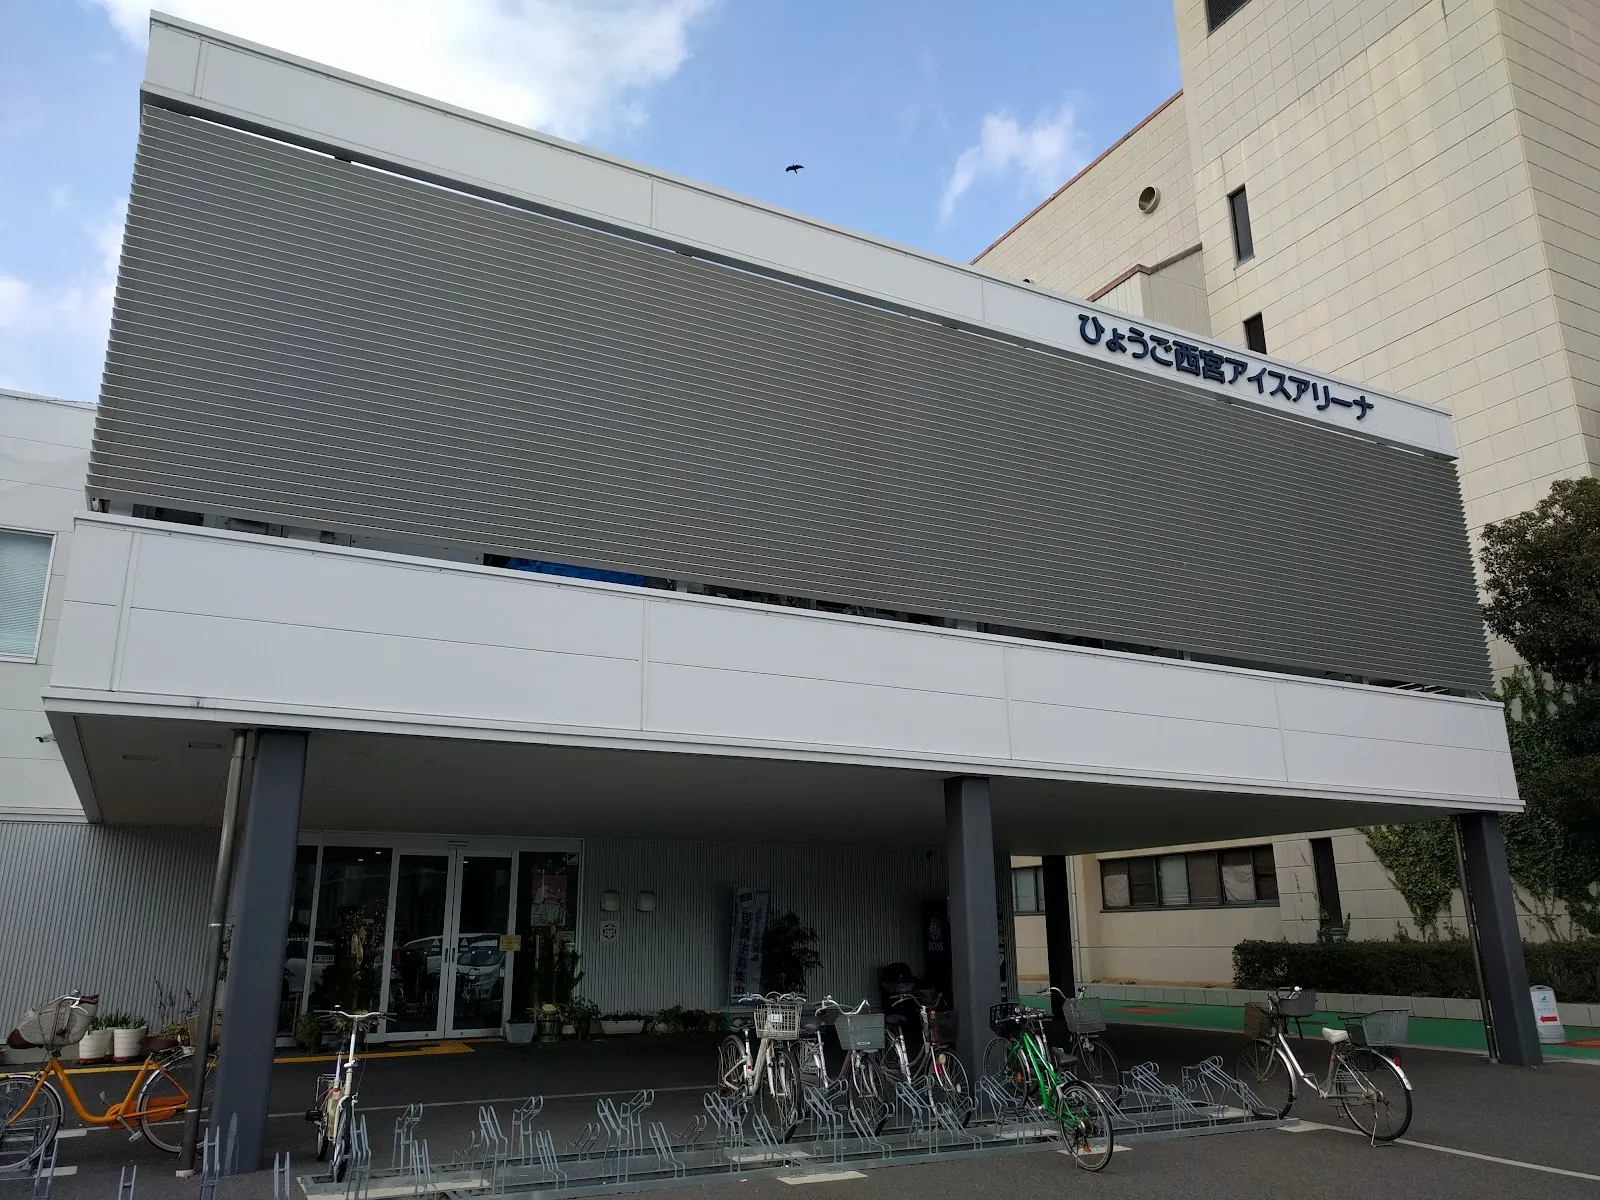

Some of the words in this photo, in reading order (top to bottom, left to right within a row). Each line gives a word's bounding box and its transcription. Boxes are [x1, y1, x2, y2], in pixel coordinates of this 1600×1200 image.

[1078, 313, 1375, 420] ひょうご西宮アイスアリーナ
[928, 941, 944, 951] BOSS
